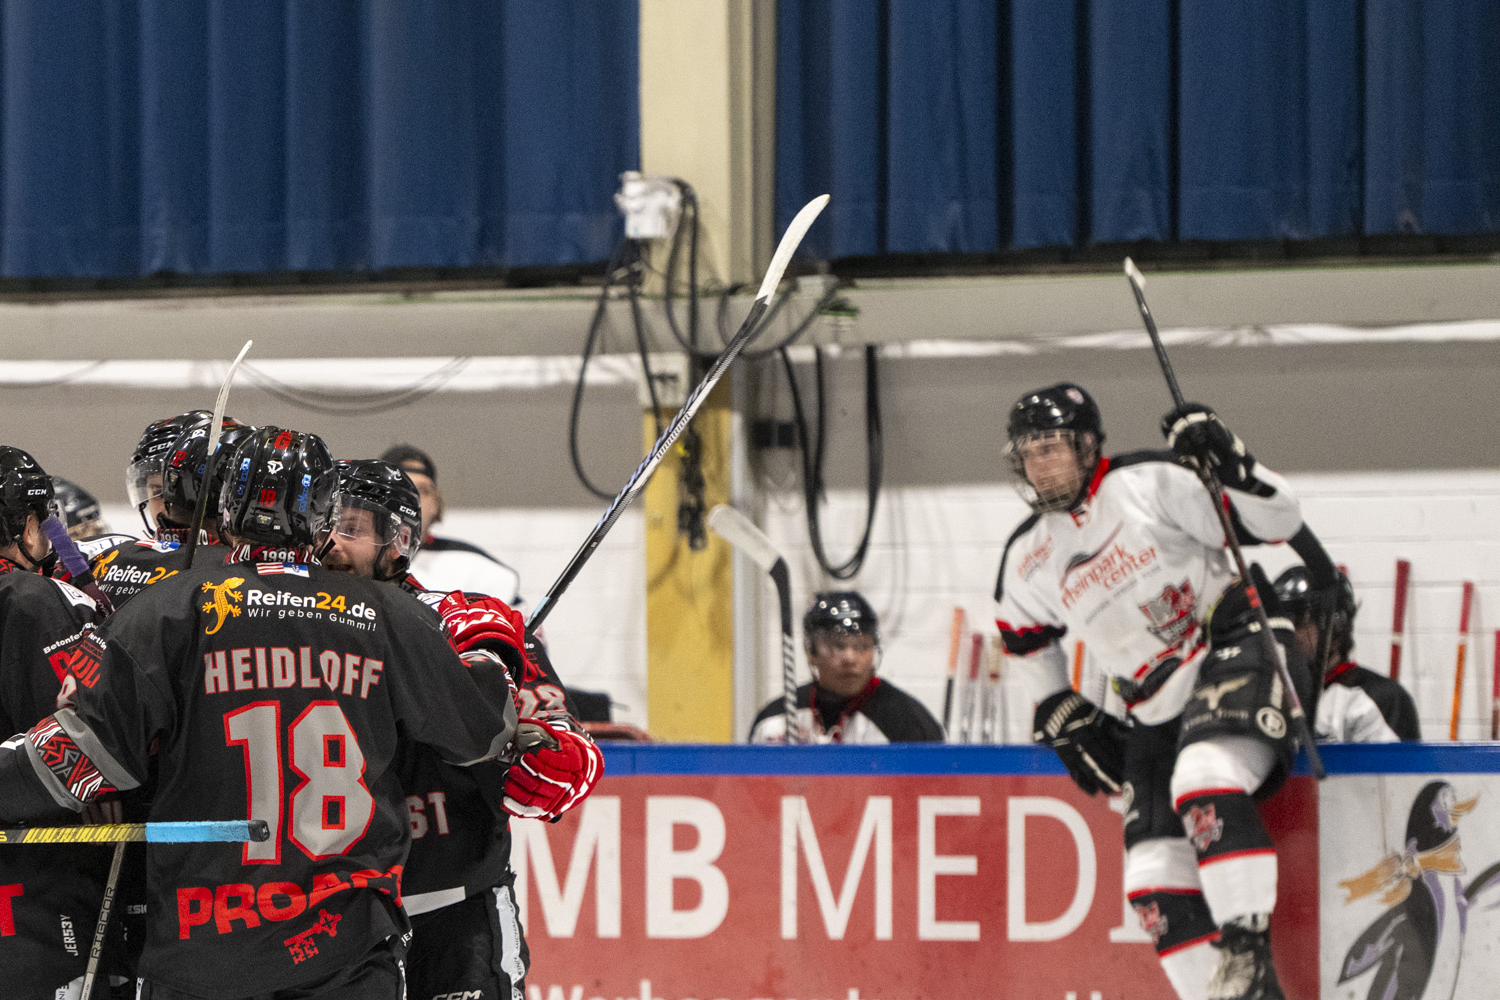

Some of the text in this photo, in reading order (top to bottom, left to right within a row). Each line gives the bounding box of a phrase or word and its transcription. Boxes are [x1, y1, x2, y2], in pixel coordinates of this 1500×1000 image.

[399, 506, 417, 517] CCM
[262, 551, 296, 563] 1996
[247, 590, 376, 620] Reifen24.de
[248, 608, 377, 632] Wir geben Gummi!
[203, 646, 384, 700] HEIDLOFF
[222, 699, 377, 866] 18
[59, 913, 79, 957] JER53Y
